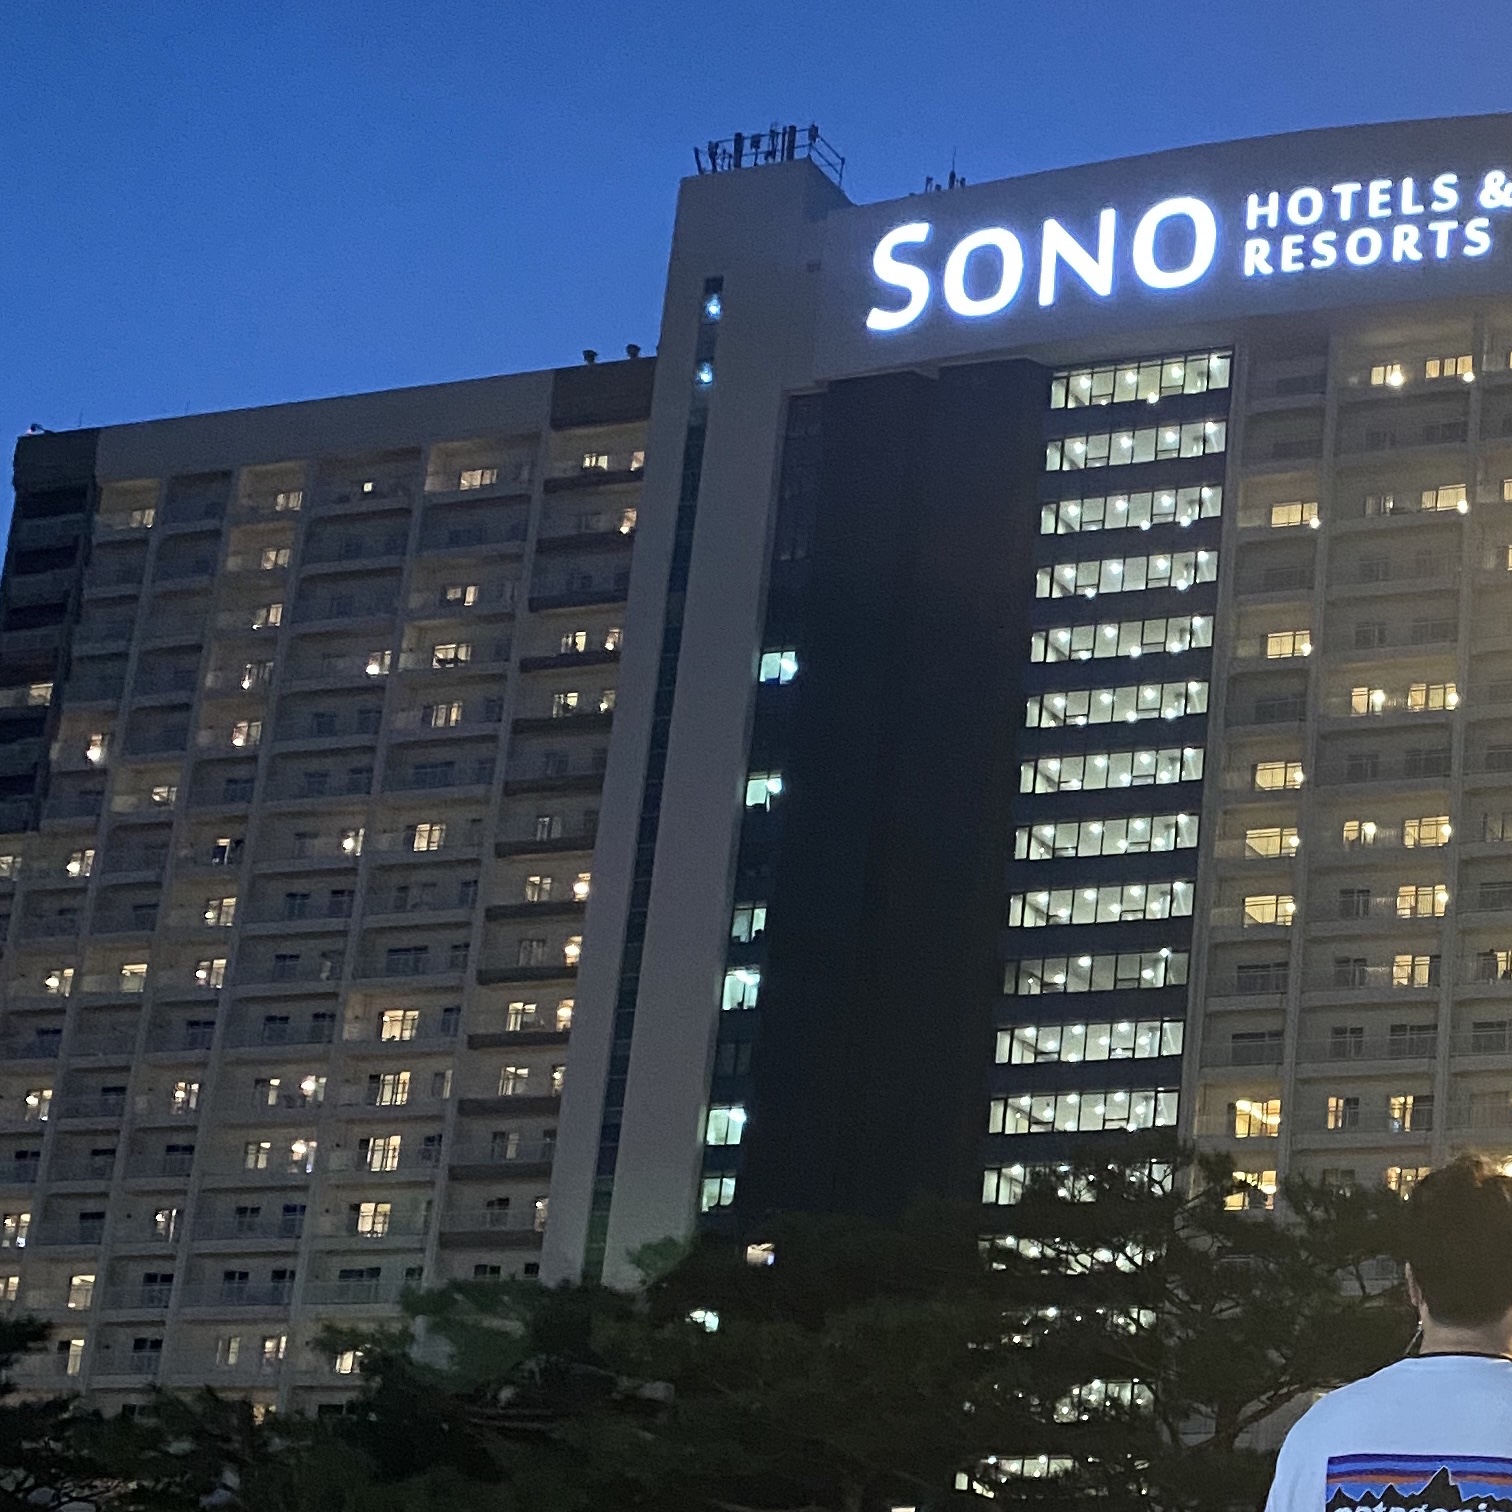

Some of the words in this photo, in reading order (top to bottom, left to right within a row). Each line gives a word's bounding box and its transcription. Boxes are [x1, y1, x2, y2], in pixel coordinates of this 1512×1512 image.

[1245, 173, 1460, 231] HOTELS
[865, 196, 1218, 332] SONO
[1243, 217, 1492, 278] RESORTS
